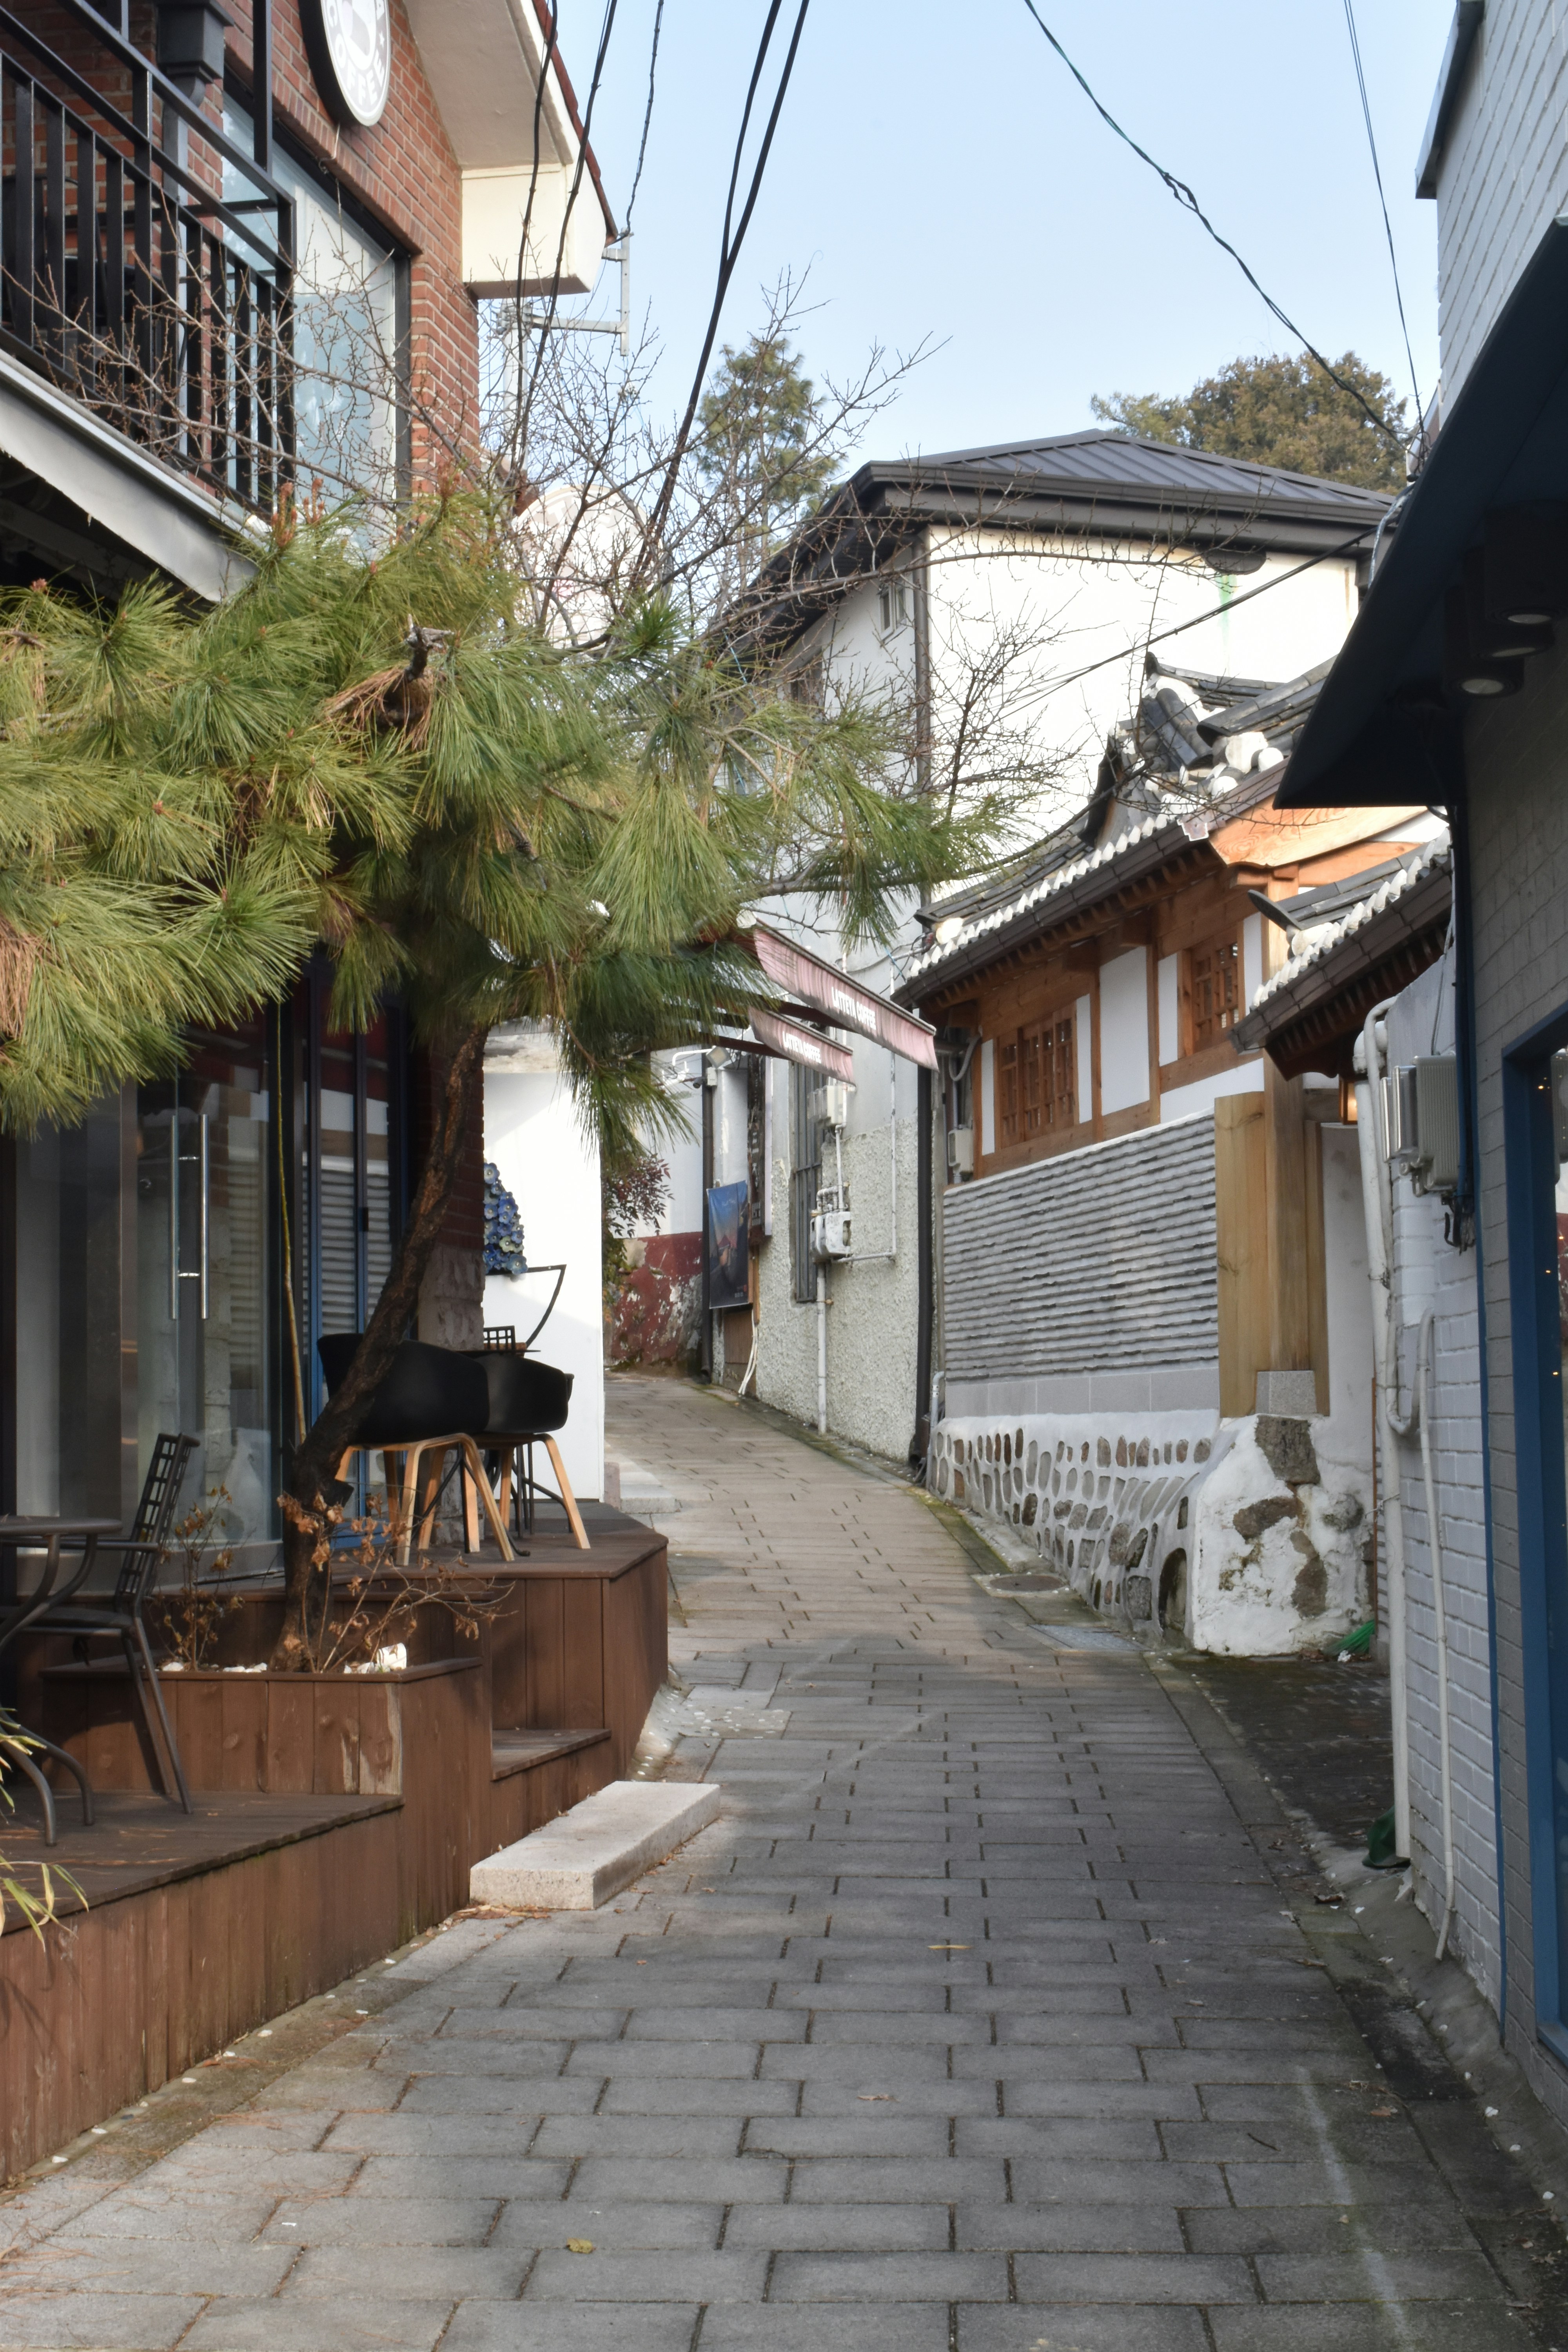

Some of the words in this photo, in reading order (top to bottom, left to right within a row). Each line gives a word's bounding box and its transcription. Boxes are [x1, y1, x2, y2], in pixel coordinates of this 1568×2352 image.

[326, 0, 385, 106] COFFEE
[856, 1001, 877, 1031] COFFEE
[803, 1041, 822, 1064] COFFEE
